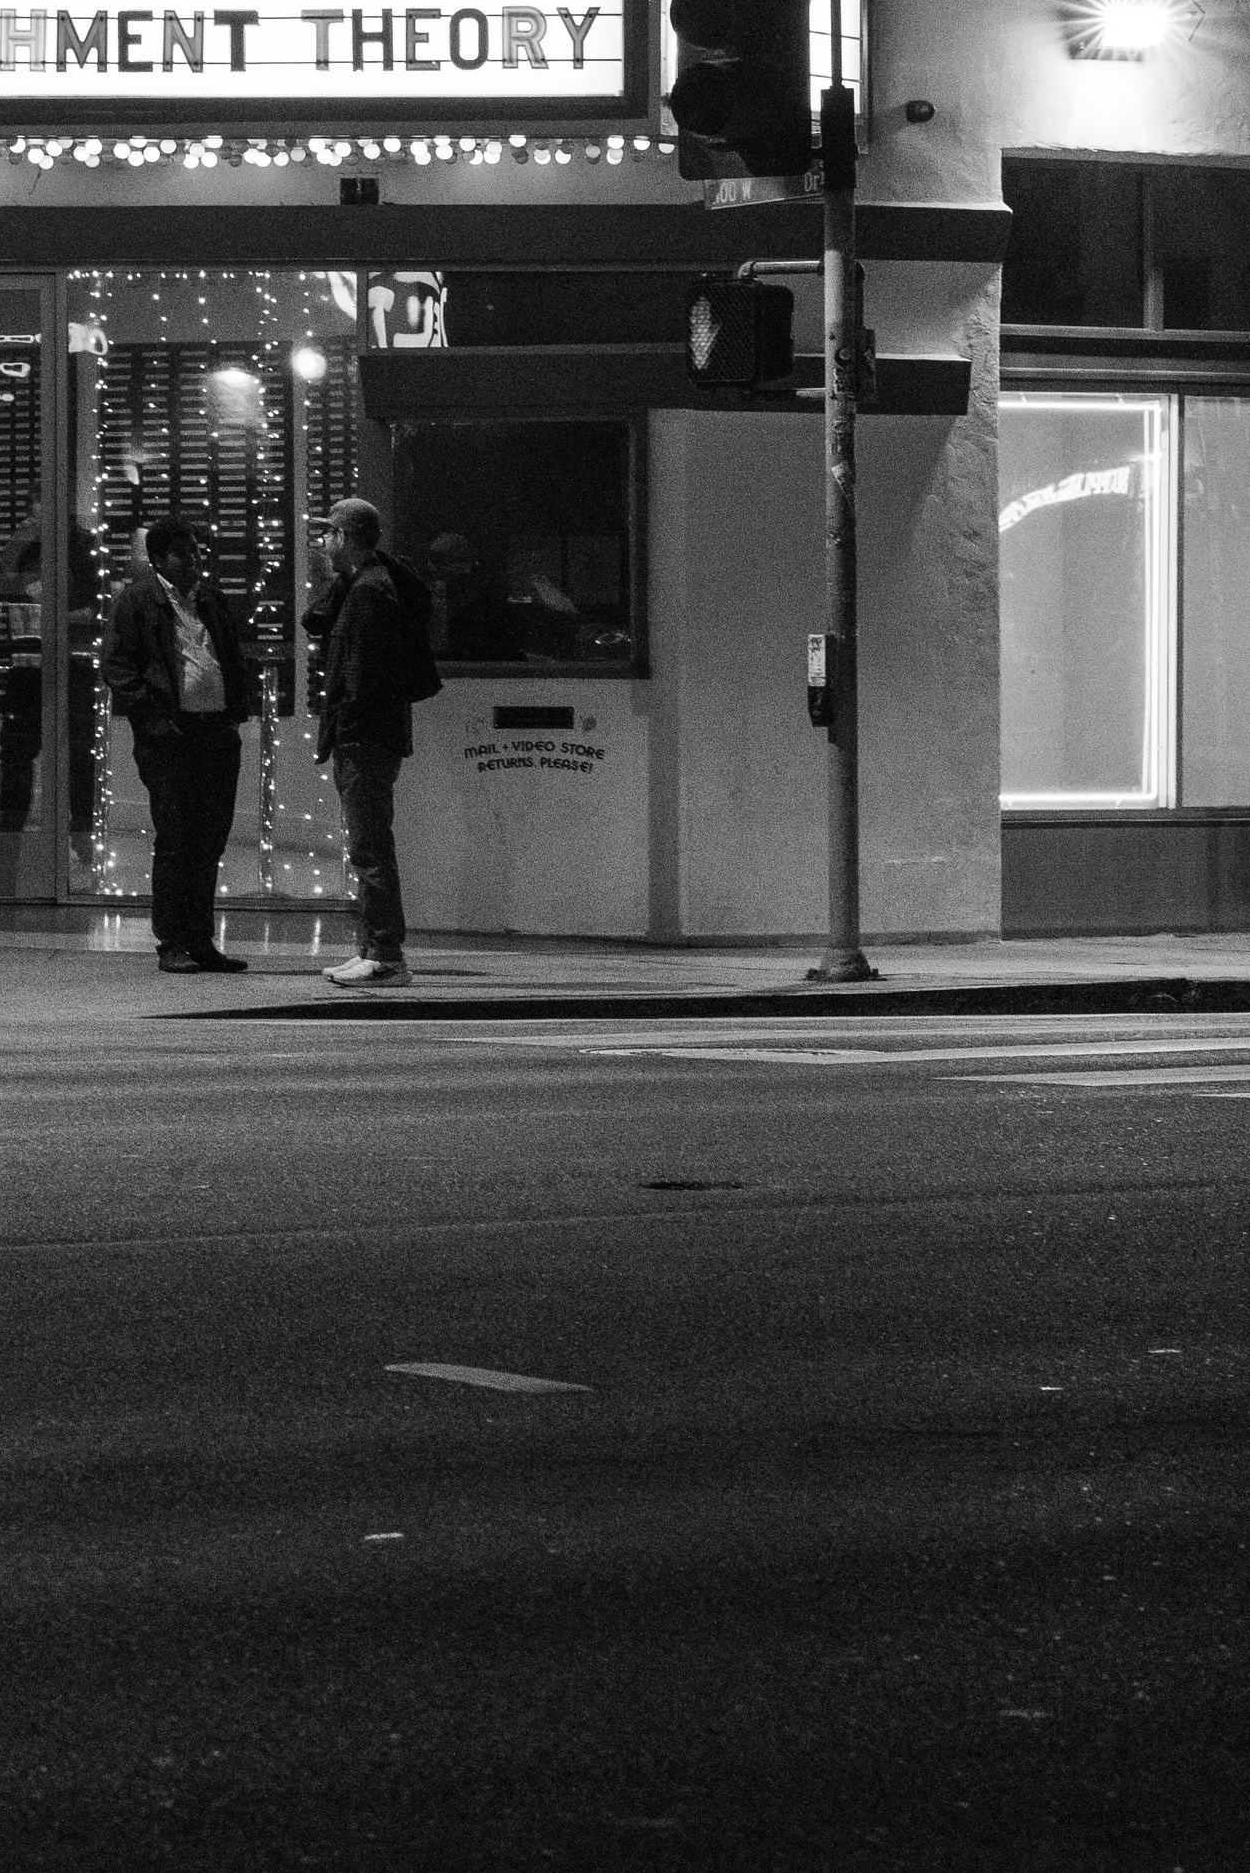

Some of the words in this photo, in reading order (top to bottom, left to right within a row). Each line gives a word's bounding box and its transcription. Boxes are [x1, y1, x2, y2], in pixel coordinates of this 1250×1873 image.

[301, 5, 601, 72] THEORY
[464, 744, 500, 758] MAIL
[511, 740, 556, 752] VIDEO
[560, 742, 605, 759] STORE
[477, 757, 533, 772] RETURNS
[540, 757, 593, 773] PLEASE!
